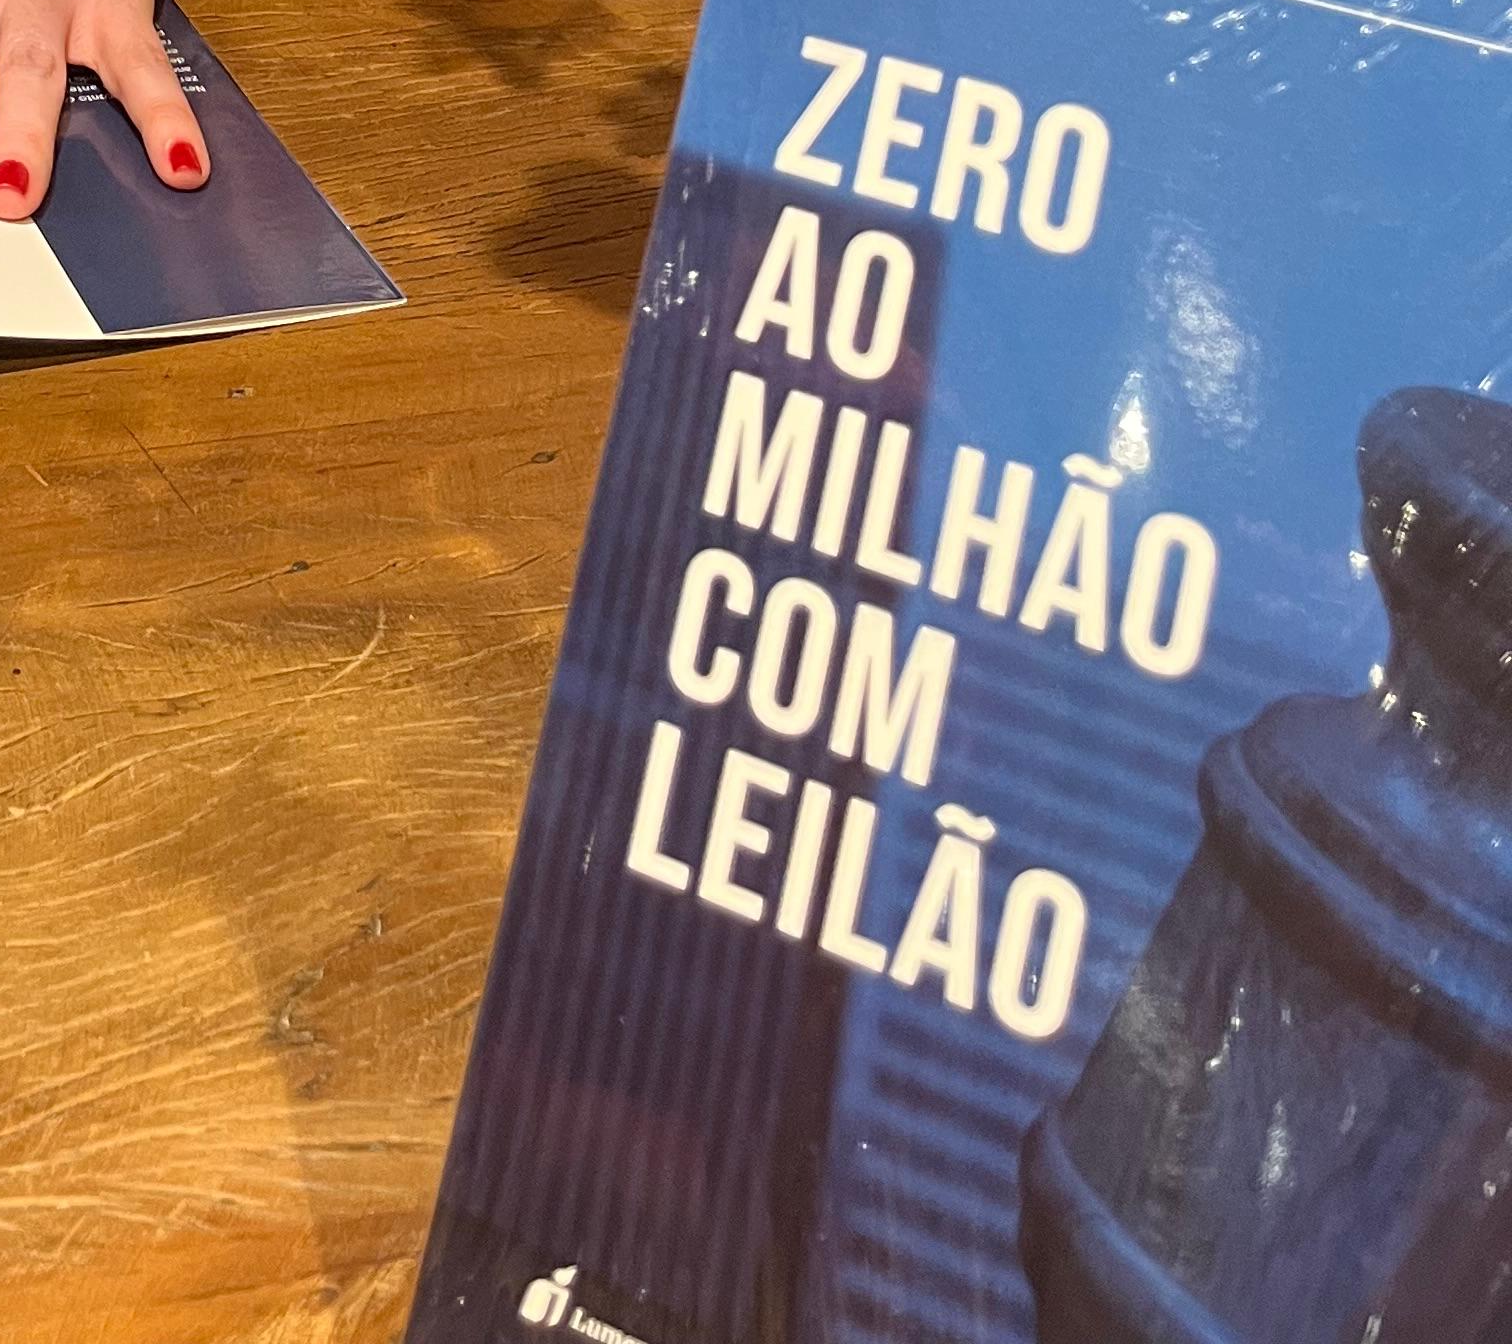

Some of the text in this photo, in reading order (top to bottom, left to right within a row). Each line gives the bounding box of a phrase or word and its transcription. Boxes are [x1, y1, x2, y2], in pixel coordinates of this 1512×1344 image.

[774, 36, 1110, 254] ZERO
[735, 206, 915, 381] AO
[702, 370, 1217, 677] MILHÃO
[668, 548, 956, 788] COM
[627, 720, 1088, 1039] LEILÃO
